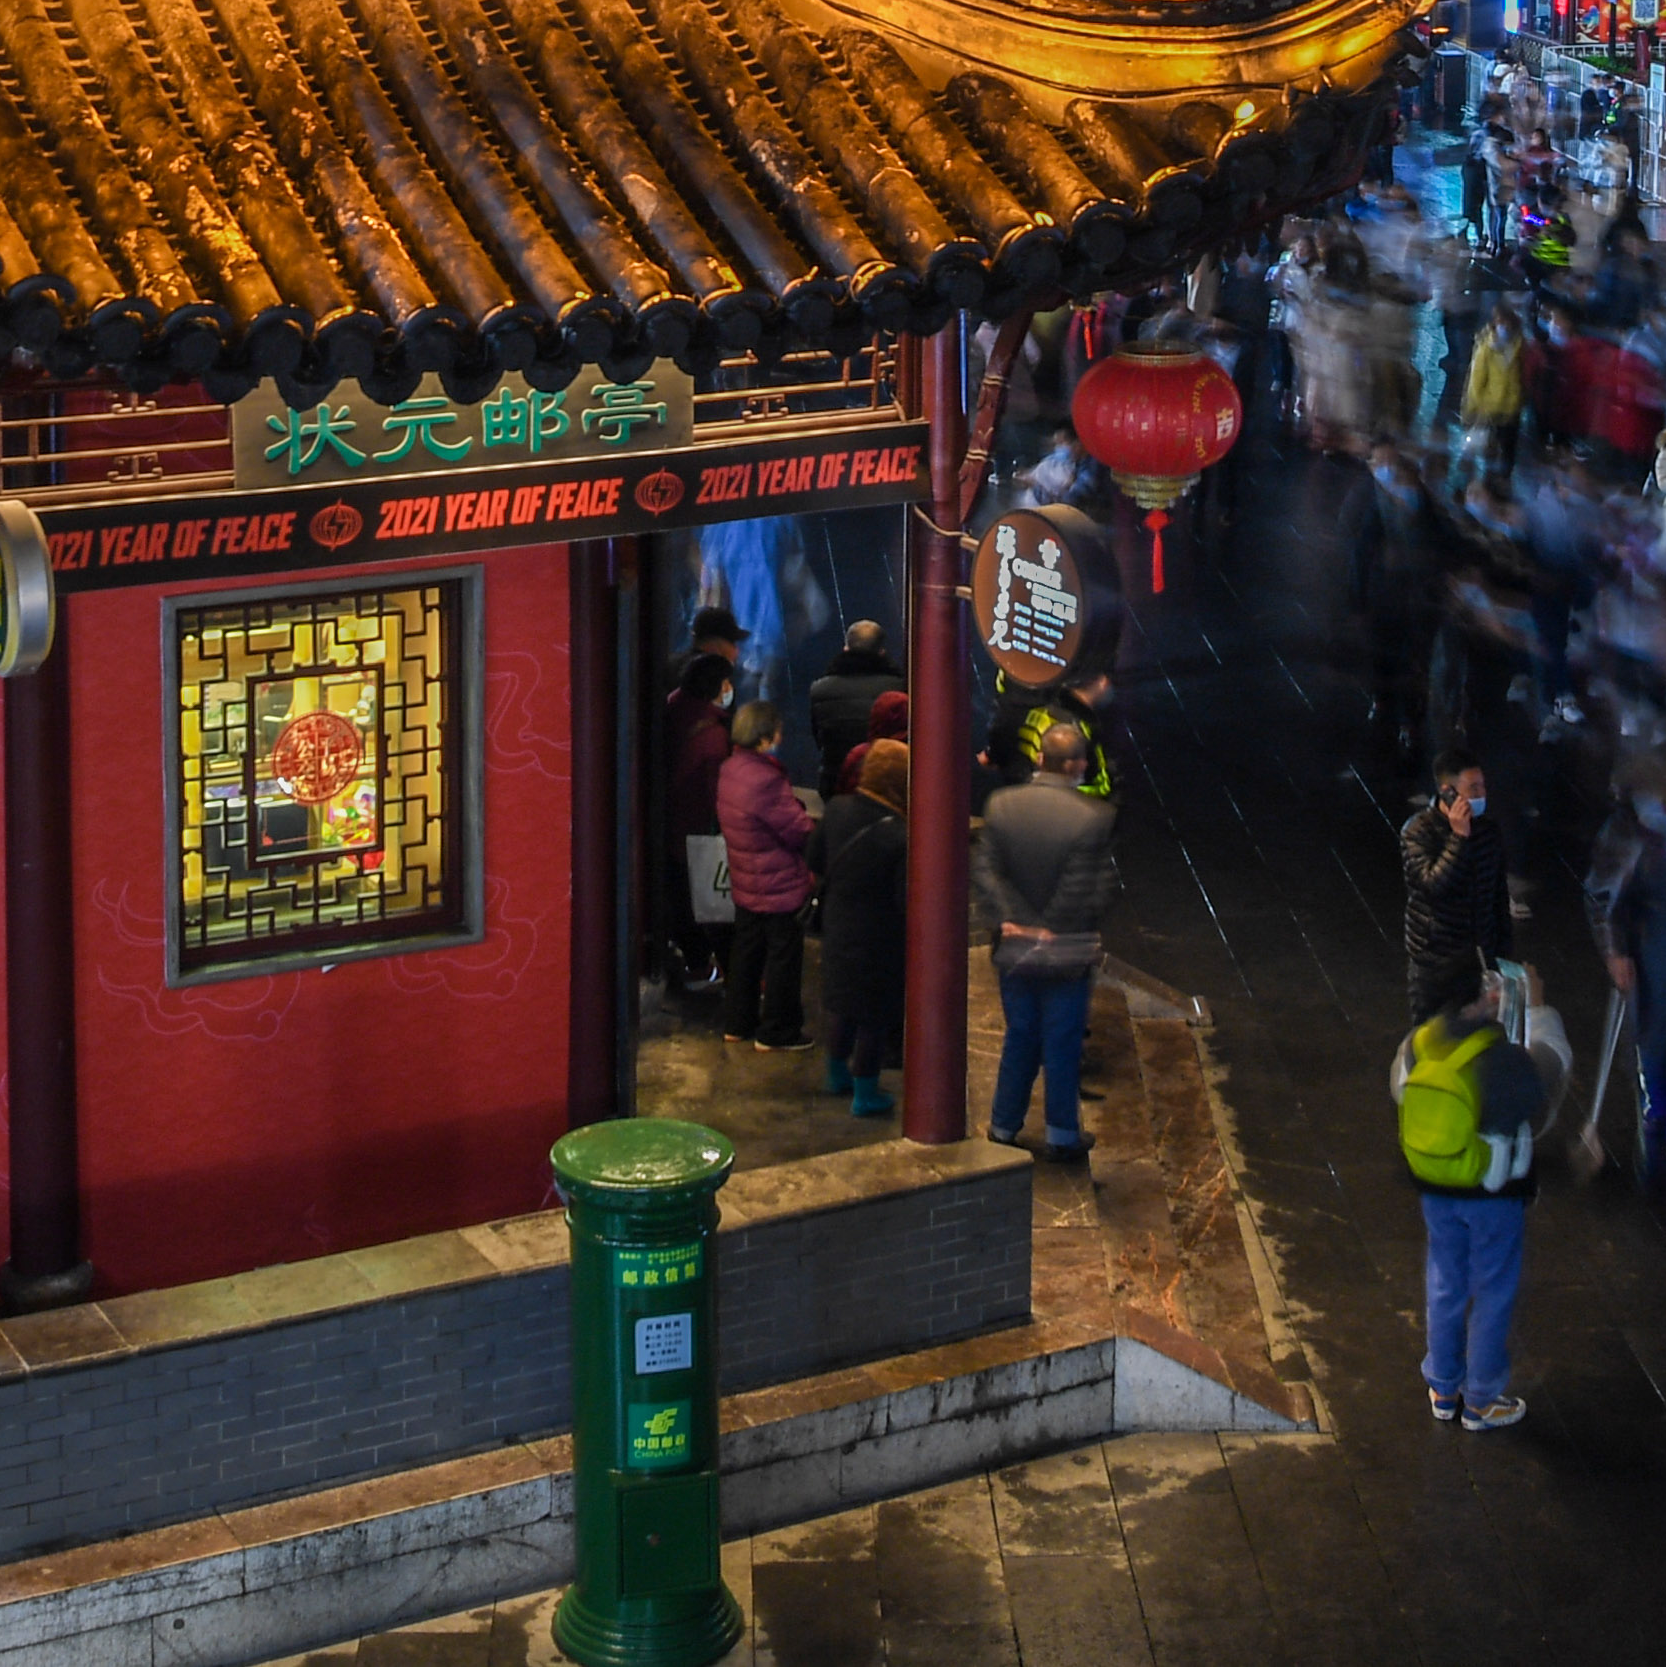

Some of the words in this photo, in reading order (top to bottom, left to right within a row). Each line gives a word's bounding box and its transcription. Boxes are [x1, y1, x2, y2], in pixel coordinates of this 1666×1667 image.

[264, 380, 668, 474] 状元邮亭
[47, 530, 94, 571] 021
[99, 523, 170, 566] YEAR
[171, 519, 210, 559] OF
[210, 511, 298, 555] PEACE
[375, 496, 440, 539] 2021
[444, 488, 510, 532] YEAR
[510, 485, 546, 525] OF
[545, 477, 624, 522] PEACE
[696, 462, 752, 505] 2021
[757, 455, 816, 497] YEAR
[816, 451, 850, 489] OF
[849, 445, 922, 486] PEACE
[633, 1433, 686, 1450] 中国邮政
